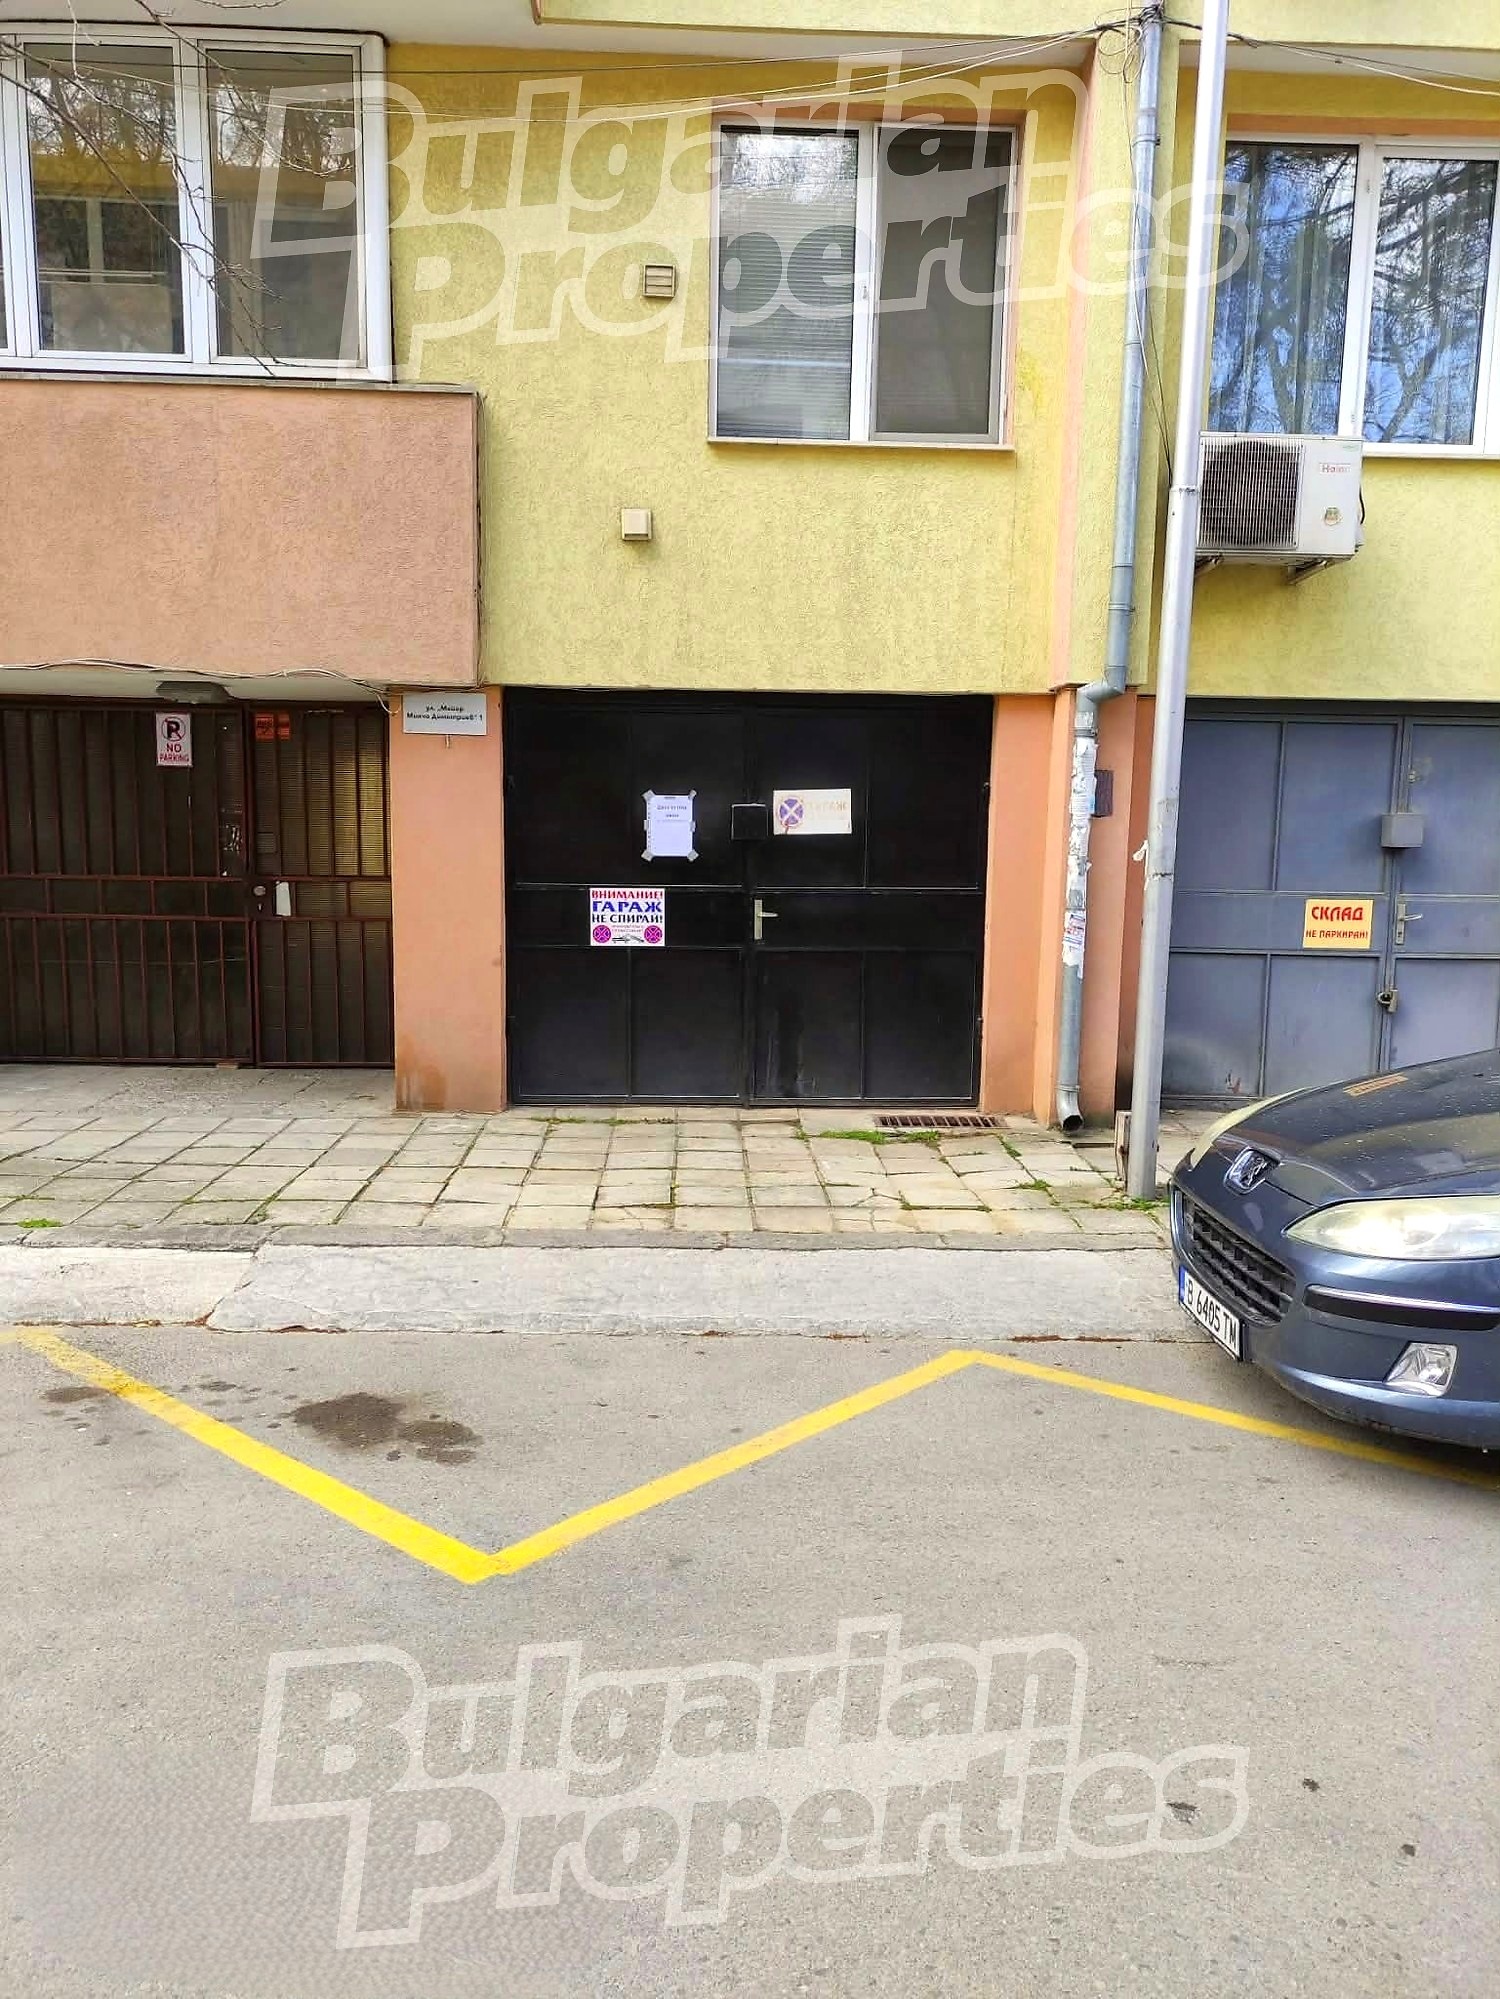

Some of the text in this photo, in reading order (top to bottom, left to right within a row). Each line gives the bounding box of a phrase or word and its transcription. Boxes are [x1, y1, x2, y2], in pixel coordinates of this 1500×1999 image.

[166, 742, 182, 753] NO
[159, 753, 190, 762] PARKING
[592, 889, 663, 899] ВНИМАНИЕ!
[592, 901, 662, 913] ГАРАЖ
[592, 913, 606, 923] НЕ
[1311, 906, 1364, 921] СКЛАД
[1305, 929, 1317, 938] НЕ
[1187, 1278, 1238, 1350] B 6405 TM
